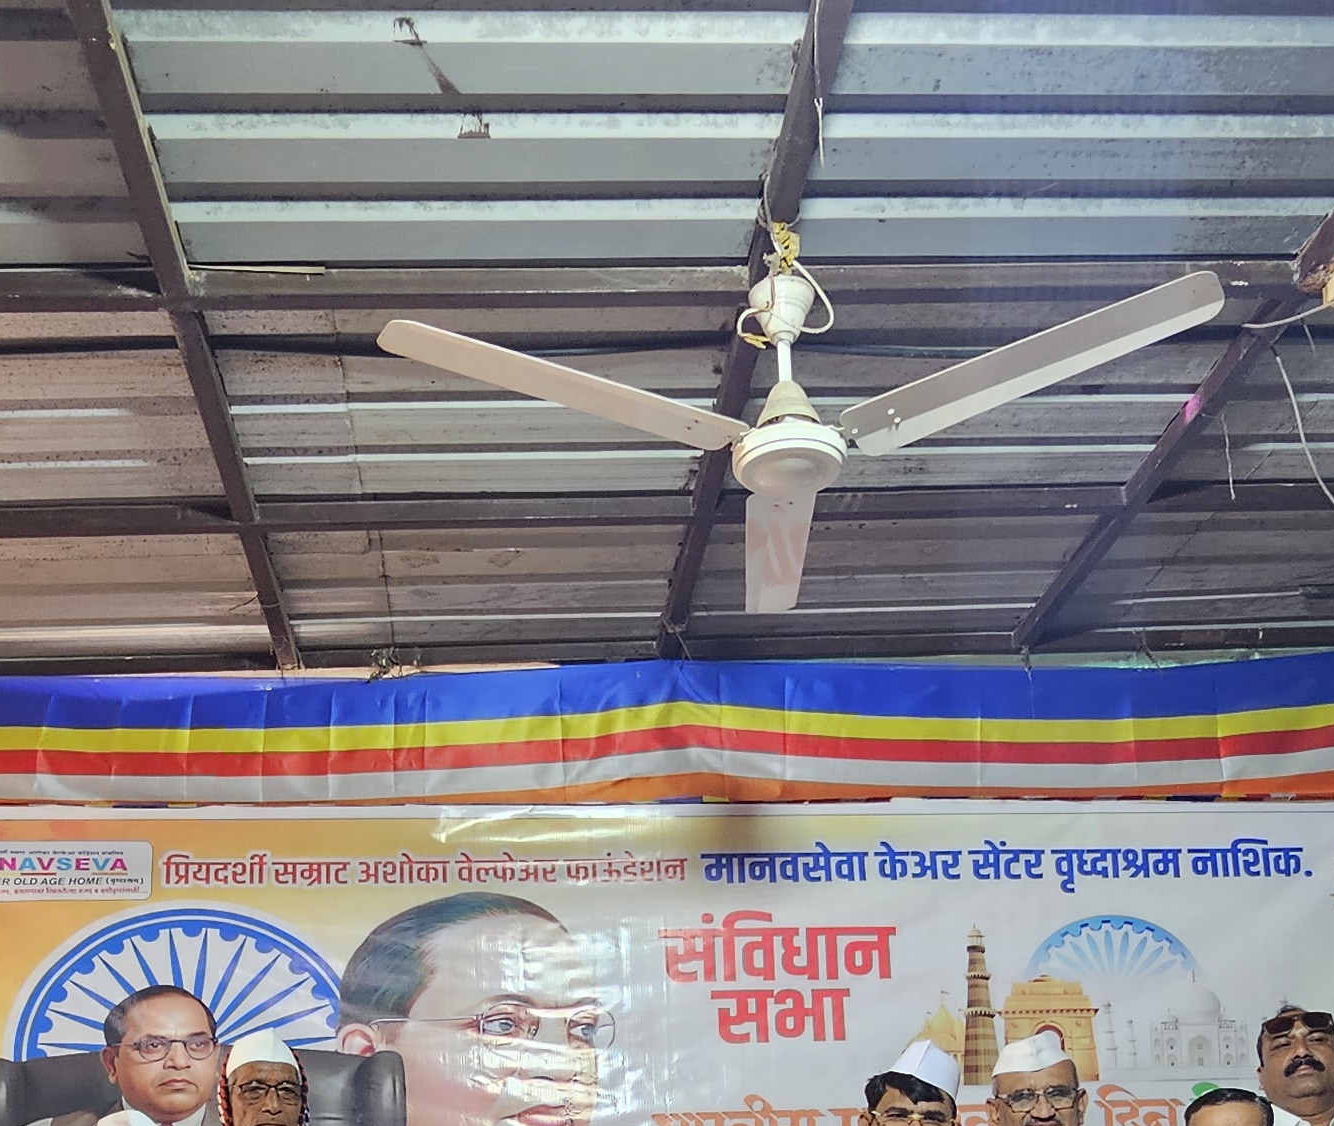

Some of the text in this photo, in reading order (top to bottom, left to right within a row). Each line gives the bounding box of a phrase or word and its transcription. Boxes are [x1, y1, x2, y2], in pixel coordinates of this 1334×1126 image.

[13, 877, 37, 886] OLD
[40, 877, 65, 886] AGE
[68, 876, 103, 885] HOME
[163, 853, 267, 886] प्रियदर्शी
[272, 859, 349, 887] सम्राट
[358, 852, 450, 885] अशोका
[455, 851, 558, 885] वेल्फेअर
[701, 841, 870, 885] मानवसेवा
[875, 841, 962, 882] केअर
[968, 839, 1046, 882] सेंटर
[1188, 838, 1314, 880] नाशिक.
[657, 909, 897, 983] संविधान
[710, 988, 851, 1044] सभा
